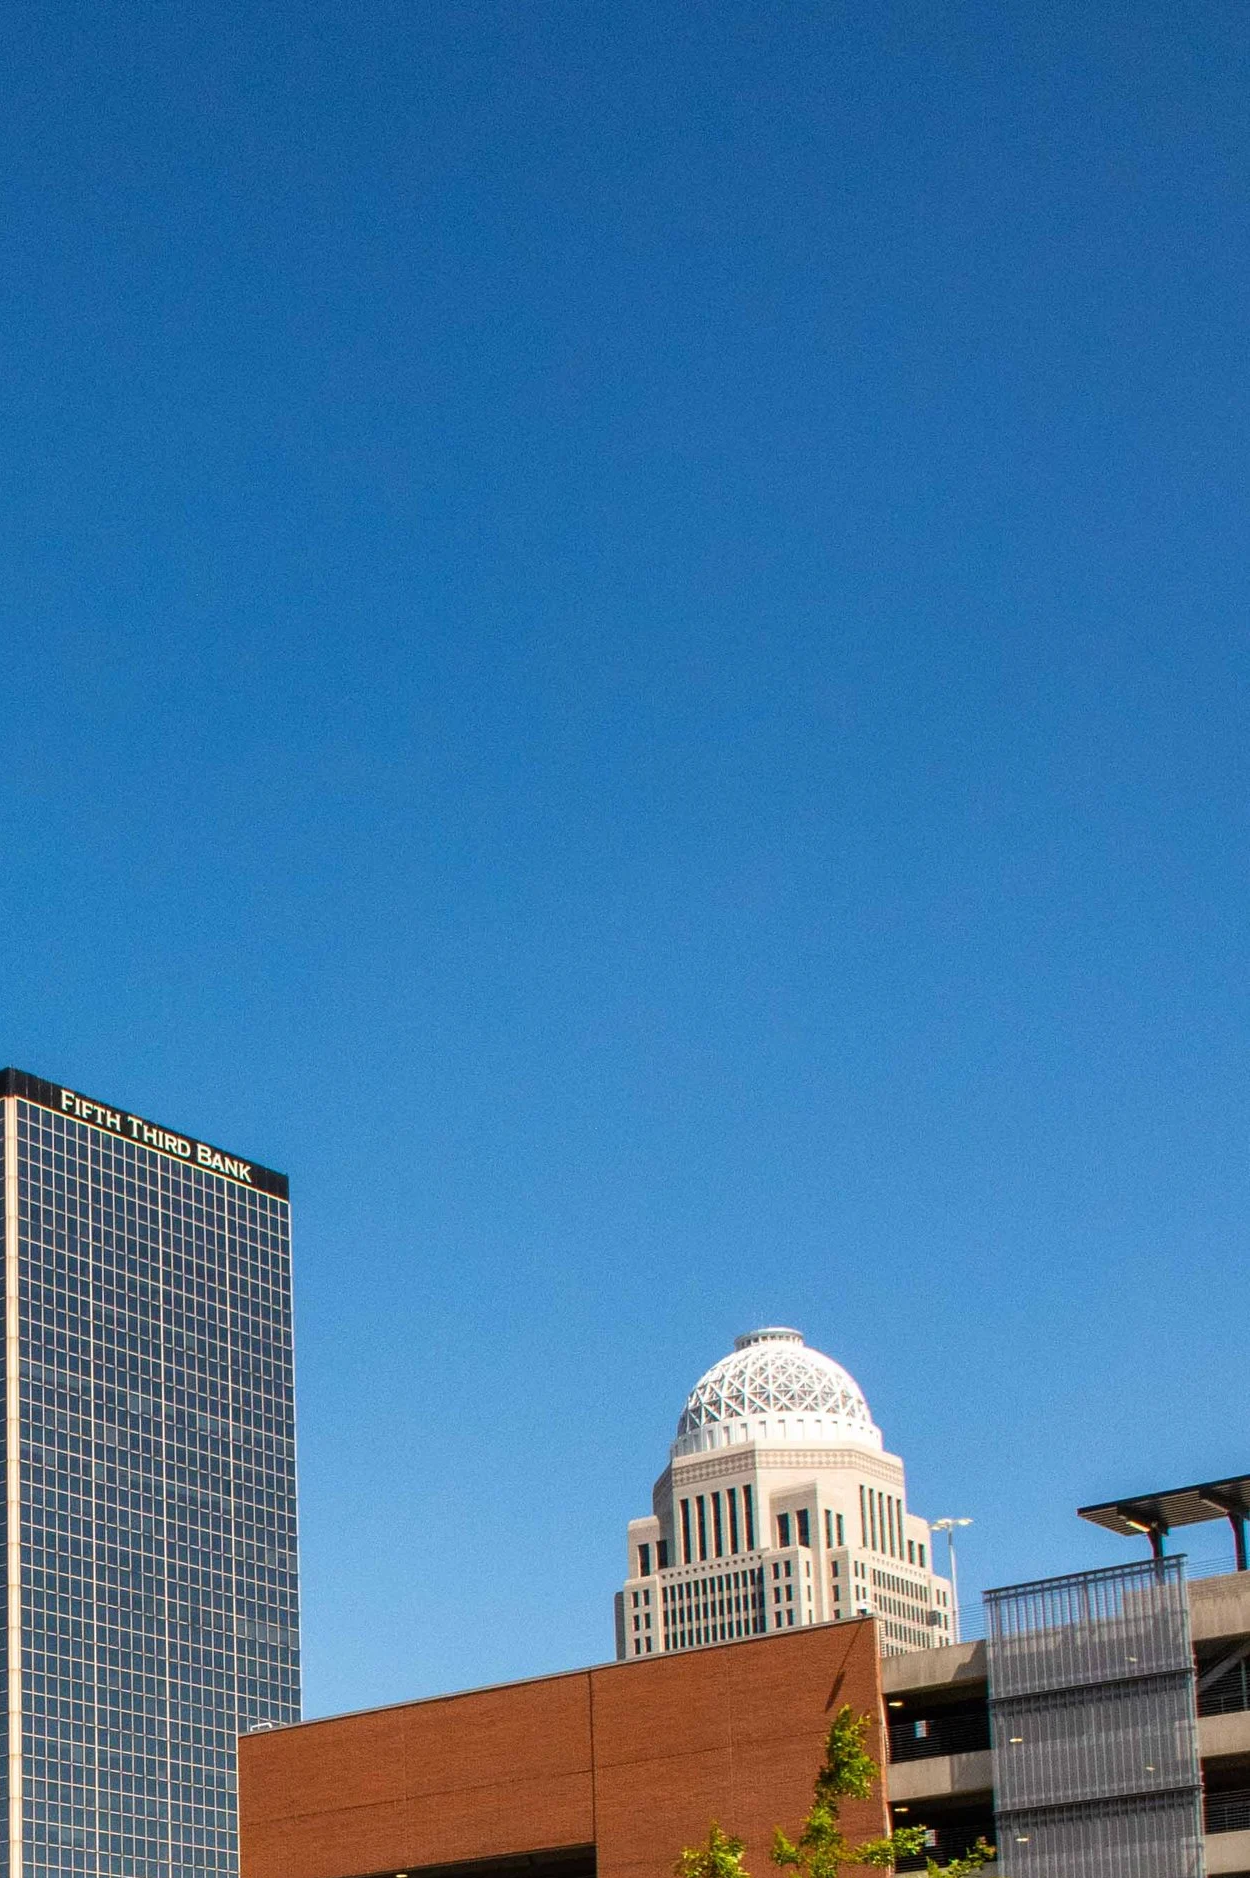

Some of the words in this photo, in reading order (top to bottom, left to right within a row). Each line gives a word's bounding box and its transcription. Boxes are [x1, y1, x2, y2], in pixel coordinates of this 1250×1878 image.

[60, 1089, 121, 1132] FIFTH
[127, 1116, 191, 1158] THIRD
[196, 1142, 252, 1183] BANK
